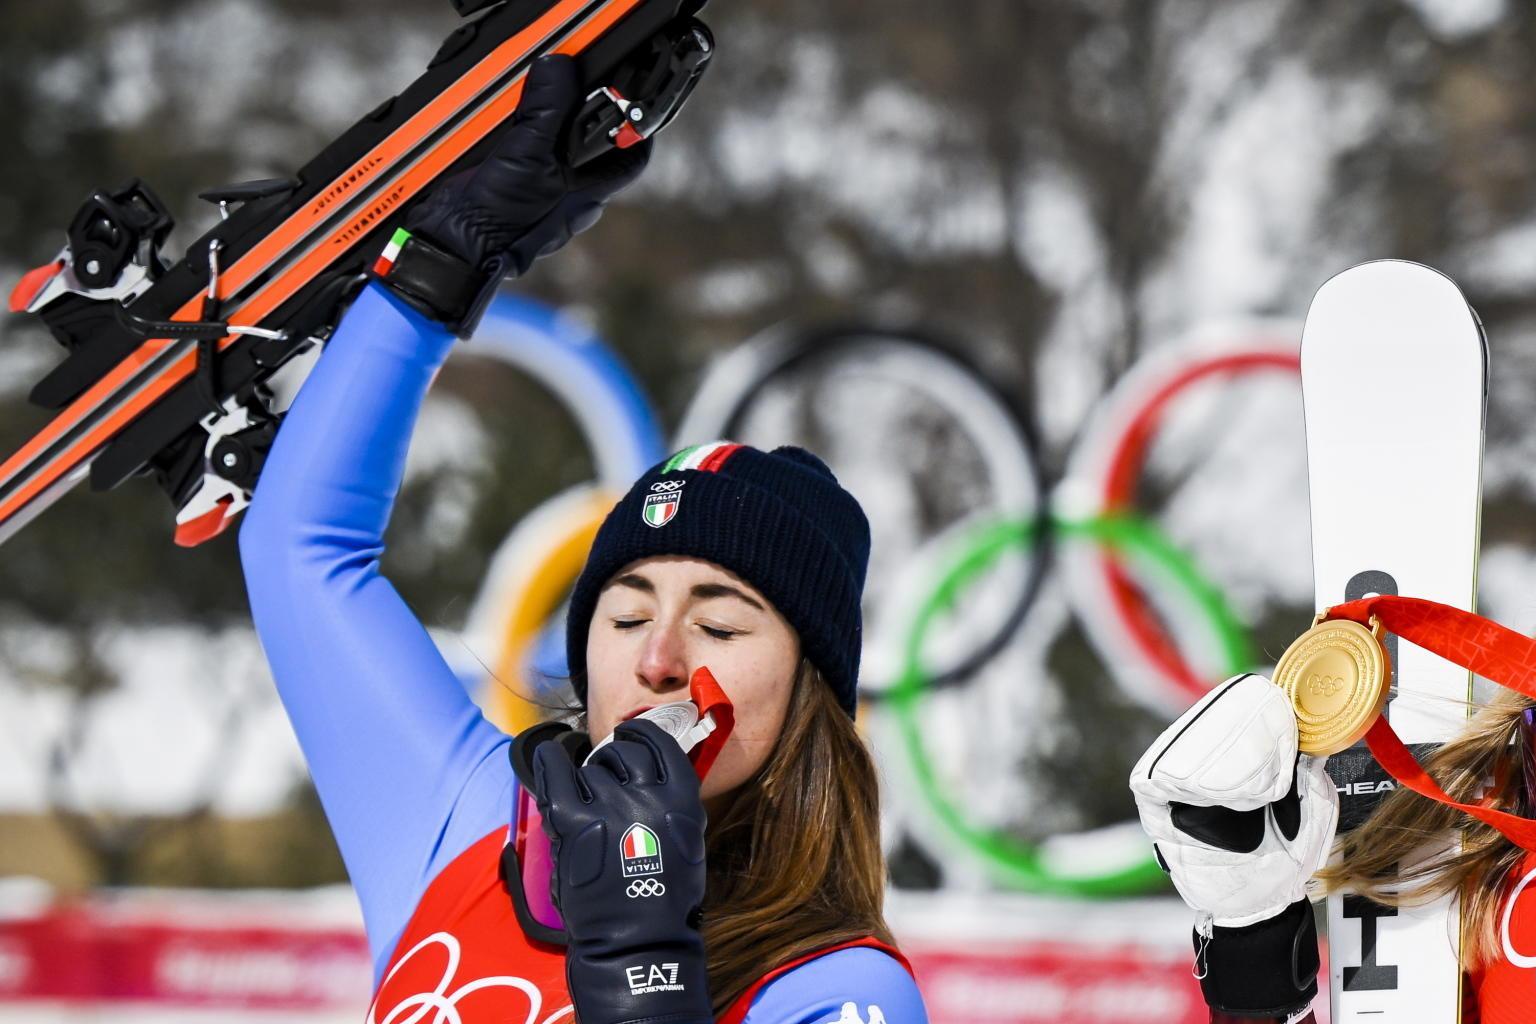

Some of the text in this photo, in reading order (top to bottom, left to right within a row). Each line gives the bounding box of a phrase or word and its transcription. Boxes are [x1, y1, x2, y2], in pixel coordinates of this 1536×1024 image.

[648, 493, 678, 502] ITALIA
[1335, 780, 1397, 796] HEA
[626, 862, 660, 873] ITALIA
[625, 963, 679, 989] EA7
